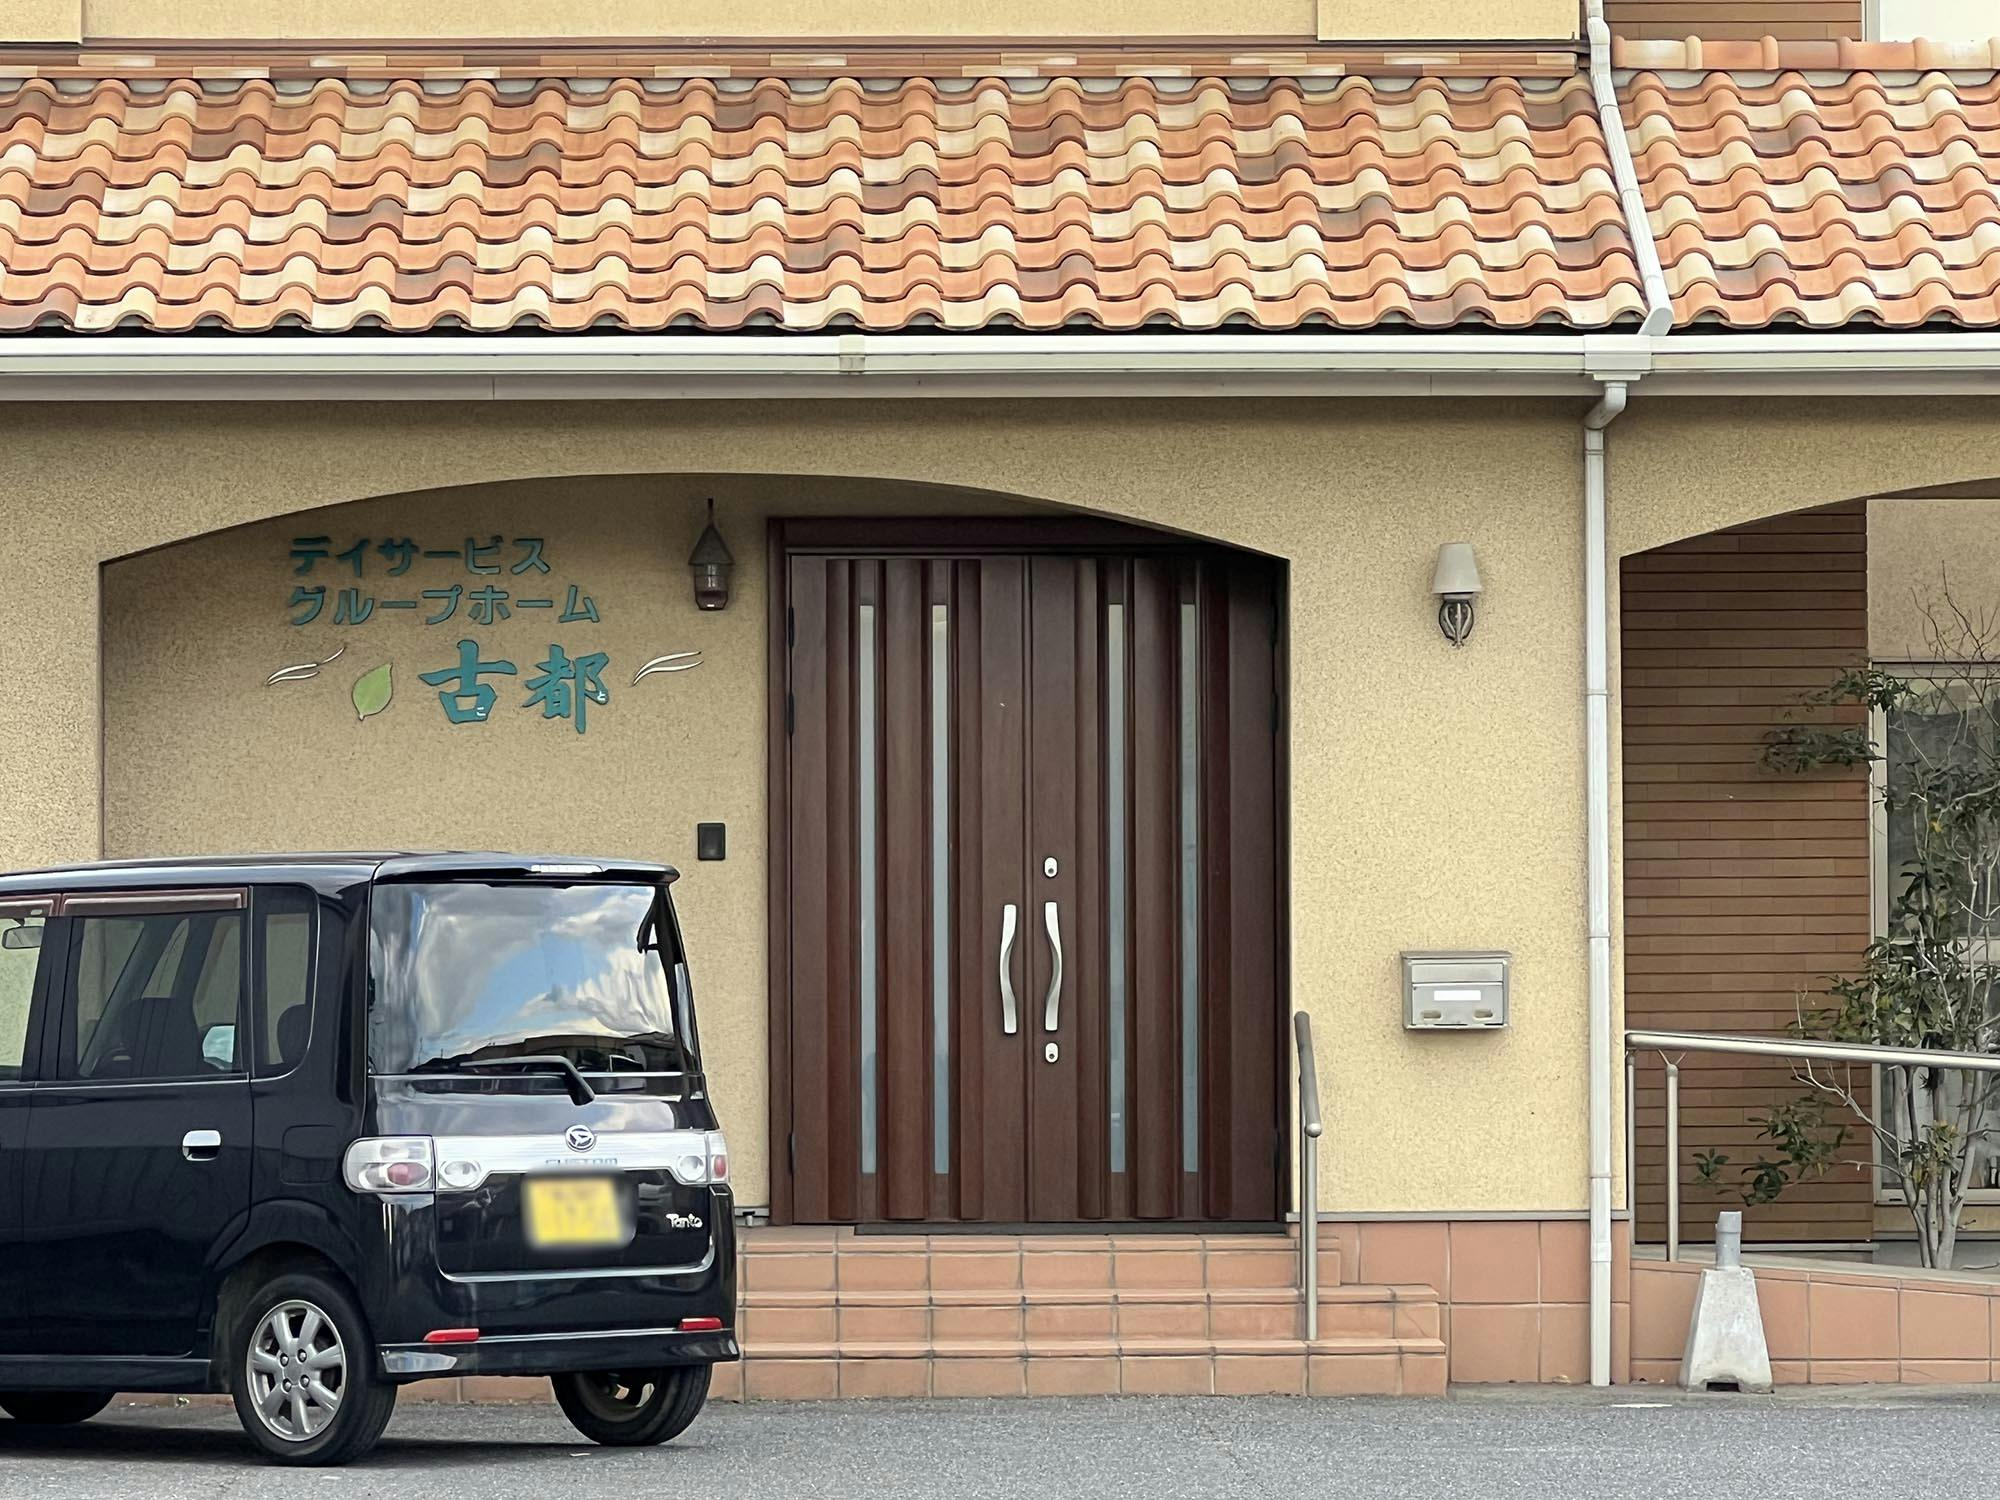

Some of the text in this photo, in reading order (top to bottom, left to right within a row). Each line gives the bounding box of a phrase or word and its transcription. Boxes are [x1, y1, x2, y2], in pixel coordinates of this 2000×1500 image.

[288, 585, 600, 626] グループホーム
[418, 639, 609, 734] 古都
[665, 1213, 703, 1228] Tanto
